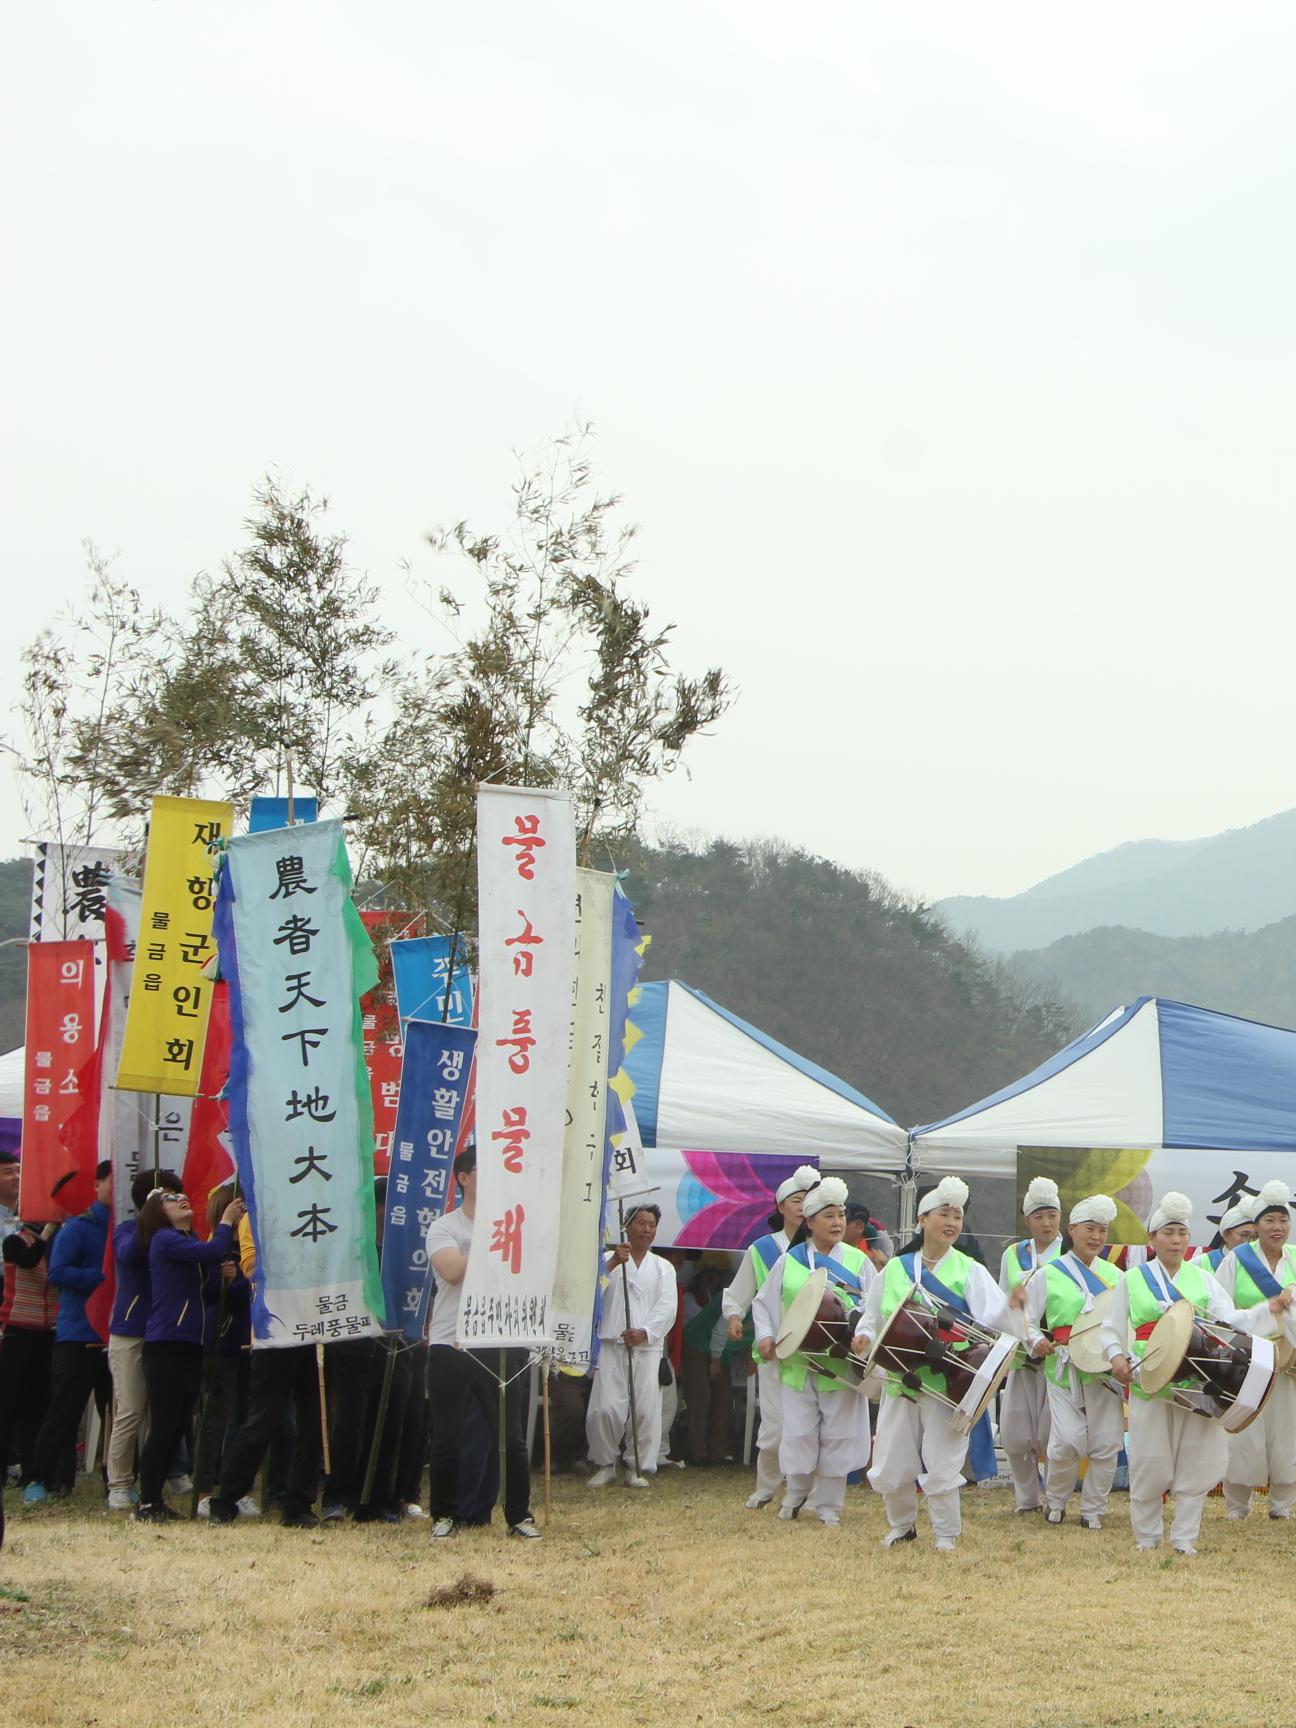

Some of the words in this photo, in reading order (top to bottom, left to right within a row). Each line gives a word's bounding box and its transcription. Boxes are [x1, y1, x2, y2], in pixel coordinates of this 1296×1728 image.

[143, 911, 171, 992] 물금읍
[32, 1051, 53, 1122] 물금읍
[268, 854, 339, 1243] 農者天下地大本
[390, 1140, 415, 1226] 물금읍
[314, 1294, 350, 1316] 물금
